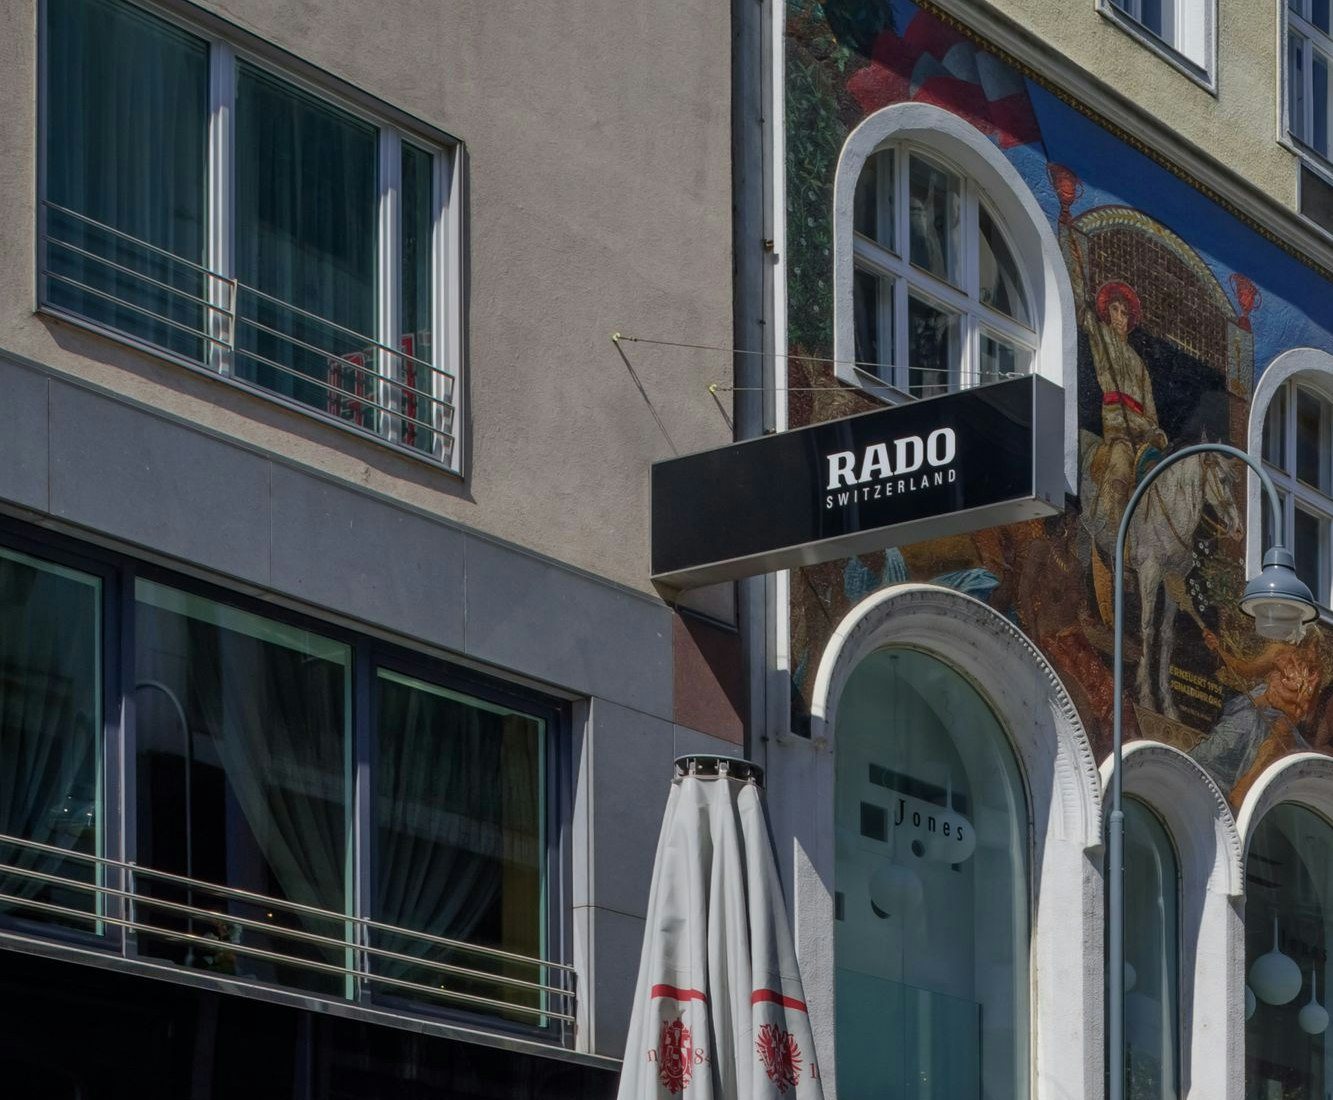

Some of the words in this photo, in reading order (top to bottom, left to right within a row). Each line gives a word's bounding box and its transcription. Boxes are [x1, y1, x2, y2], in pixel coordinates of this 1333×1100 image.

[826, 427, 956, 490] RADO
[826, 468, 957, 509] SWITZERLAND
[894, 798, 964, 841] Jones
